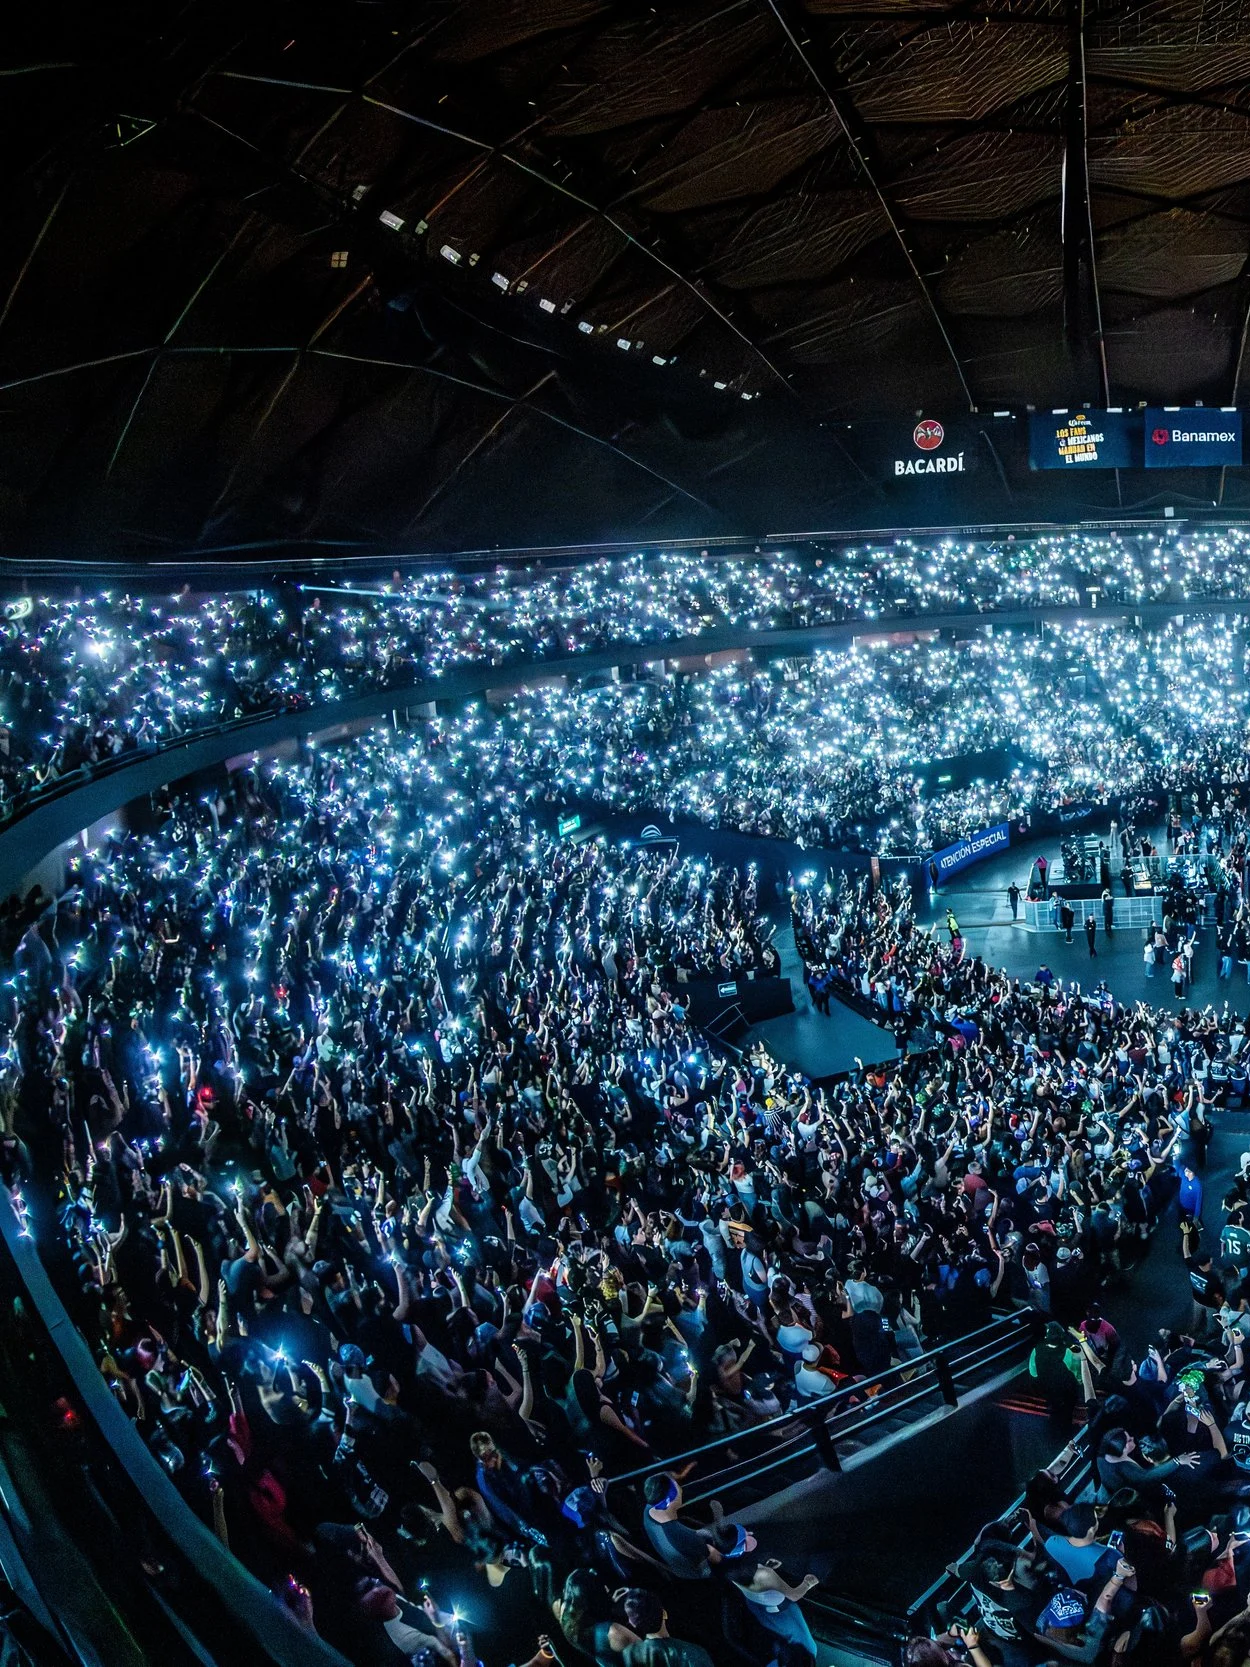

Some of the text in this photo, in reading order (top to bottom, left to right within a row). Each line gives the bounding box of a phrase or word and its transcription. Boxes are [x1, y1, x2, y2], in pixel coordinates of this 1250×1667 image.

[1067, 433, 1104, 446] MEXICANOS
[1172, 430, 1236, 442] Banamex
[894, 451, 965, 476] BACARDÍ
[971, 830, 1007, 853] ESPECIAL
[1226, 1238, 1241, 1255] 15
